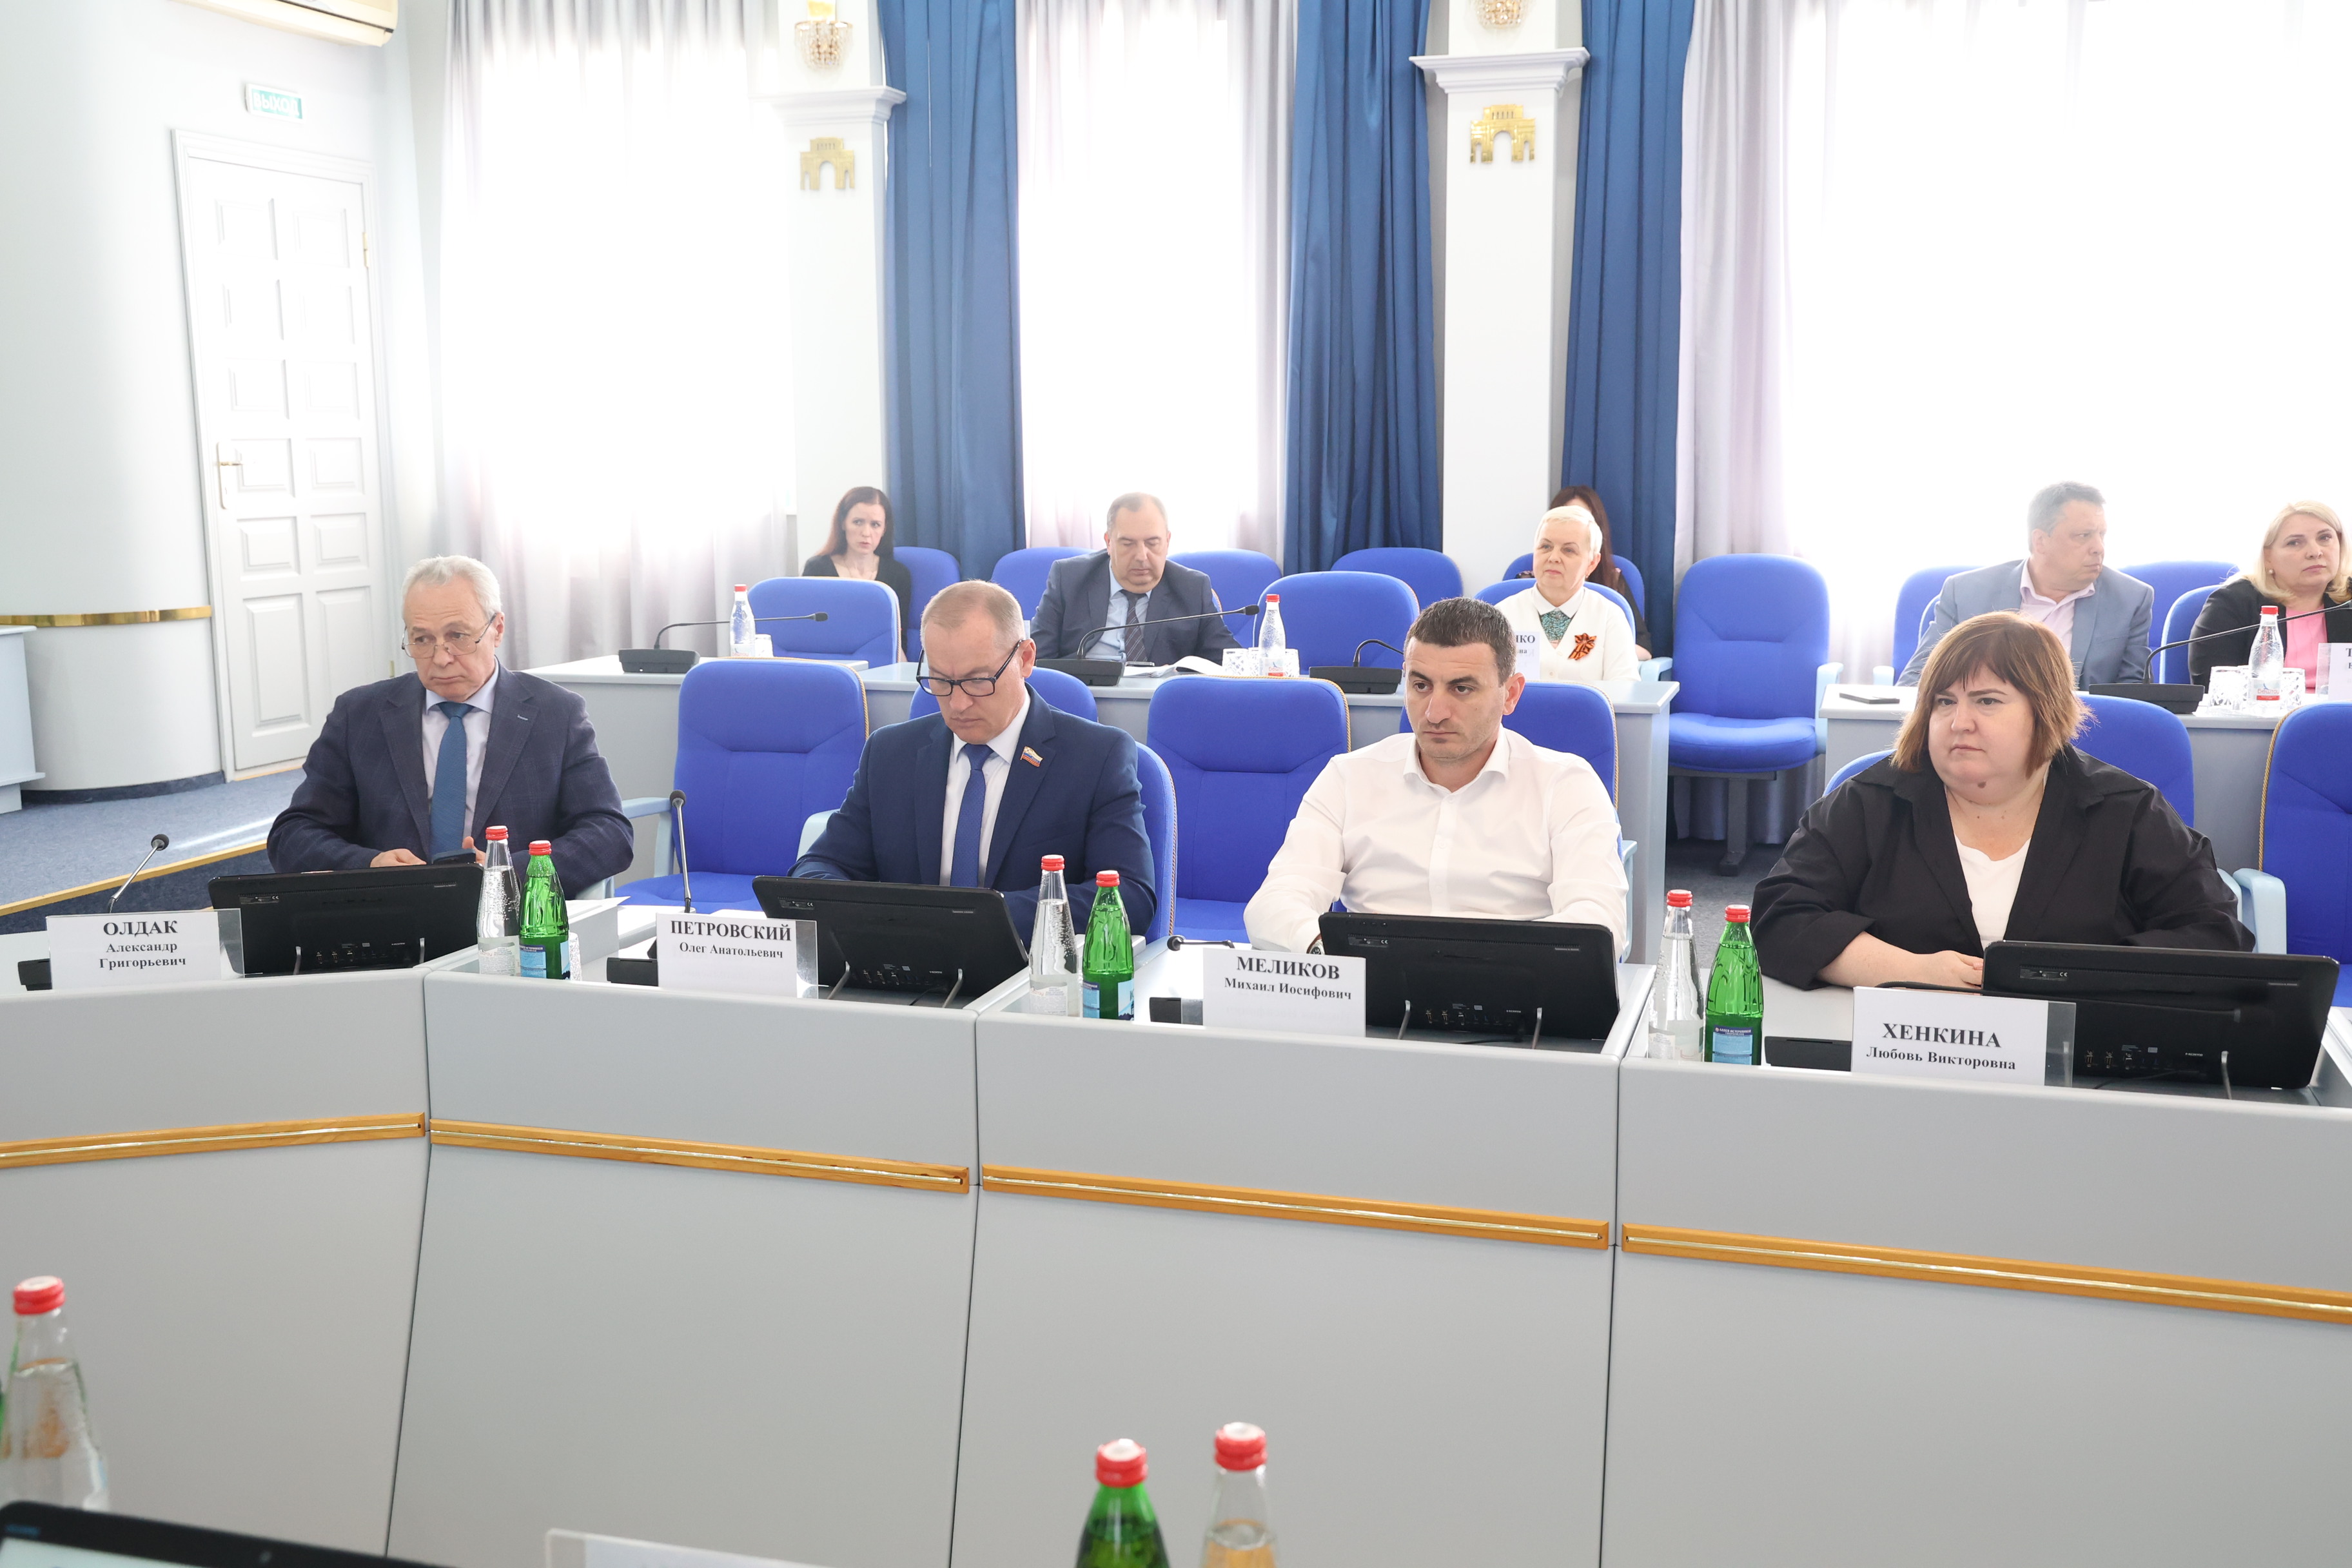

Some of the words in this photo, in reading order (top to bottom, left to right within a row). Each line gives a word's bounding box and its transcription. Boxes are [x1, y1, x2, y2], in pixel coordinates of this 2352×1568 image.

[253, 92, 300, 116] ВЫХОД
[103, 920, 178, 937] ОЛДАК
[671, 920, 792, 941] ПЕТРОВСКИЙ
[106, 943, 177, 953] Александр
[680, 941, 707, 954] Олег
[710, 945, 783, 959] Анатольевич
[99, 957, 186, 970] Григорьевич
[1237, 956, 1340, 979] МЕЛИКОВ
[1224, 977, 1275, 992] Михаил
[1279, 983, 1352, 1000] Иосифович
[1881, 1023, 2002, 1048] ХЕНКИНА
[1866, 1046, 1923, 1062] Любовь
[1928, 1052, 2016, 1070] Викторовна
